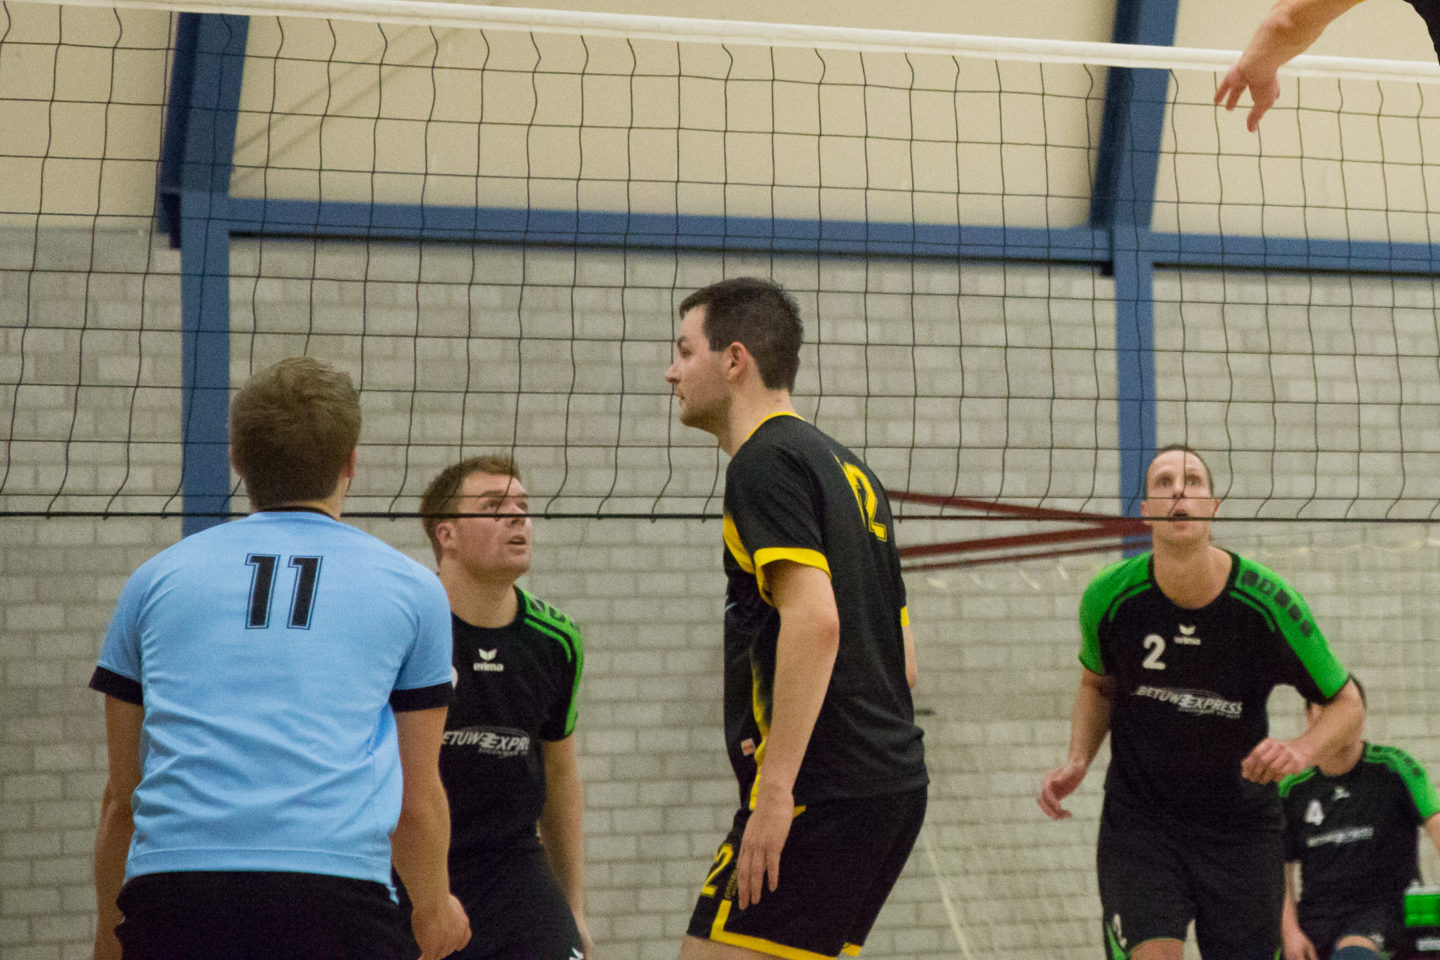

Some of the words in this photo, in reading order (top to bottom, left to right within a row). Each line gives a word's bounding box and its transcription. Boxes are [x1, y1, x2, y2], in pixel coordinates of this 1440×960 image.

[244, 552, 324, 631] 11
[472, 662, 504, 672] erima
[1142, 633, 1166, 670] 2
